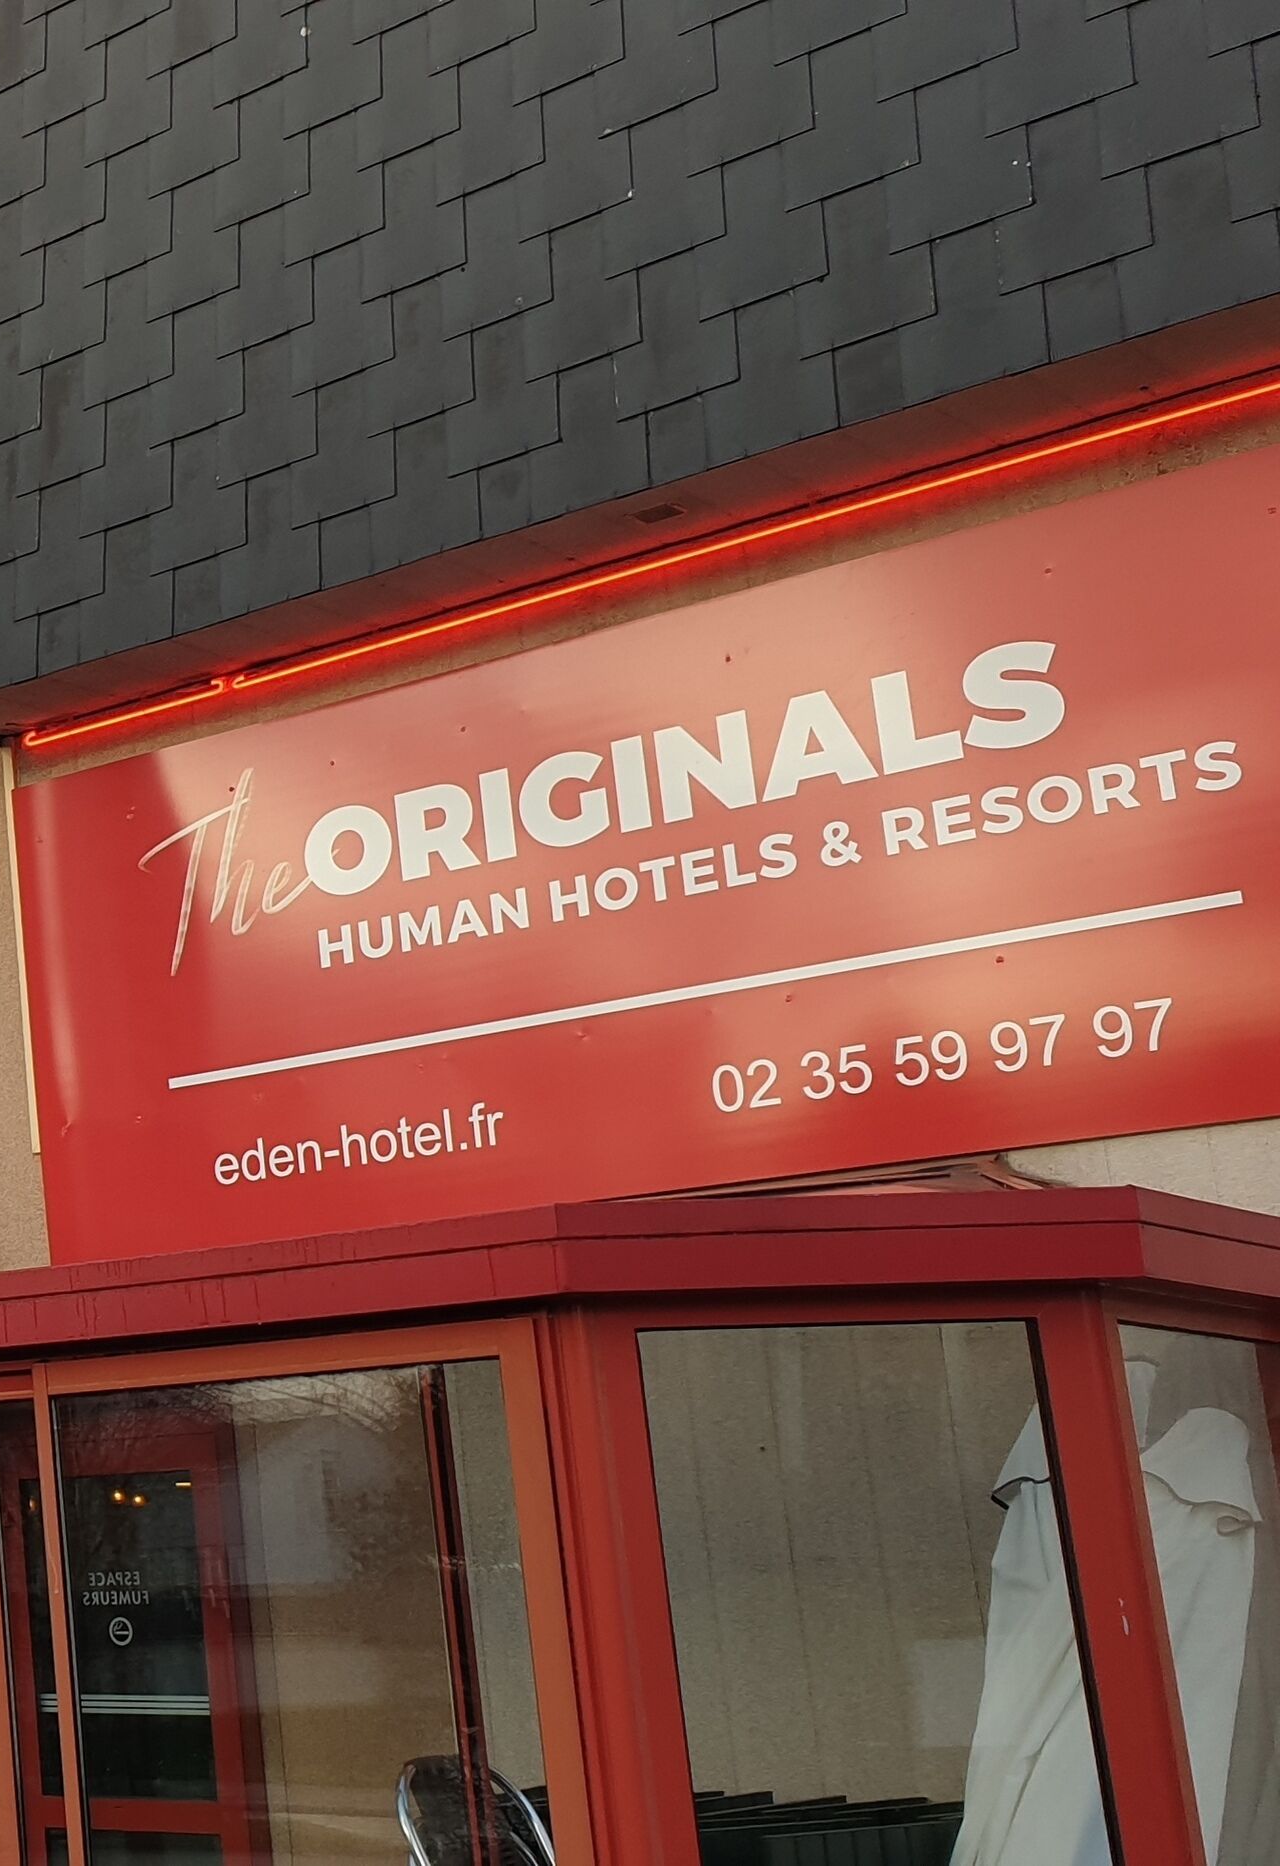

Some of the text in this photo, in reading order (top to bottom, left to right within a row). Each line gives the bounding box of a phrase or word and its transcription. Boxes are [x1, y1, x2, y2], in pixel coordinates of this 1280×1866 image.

[137, 641, 1065, 977] The ORIGINALS
[317, 741, 1243, 970] HUMAN HOTELS & RESORTS
[712, 997, 1173, 1113] 02 35 59 97 97
[214, 1103, 504, 1185] eden-hotel.fr
